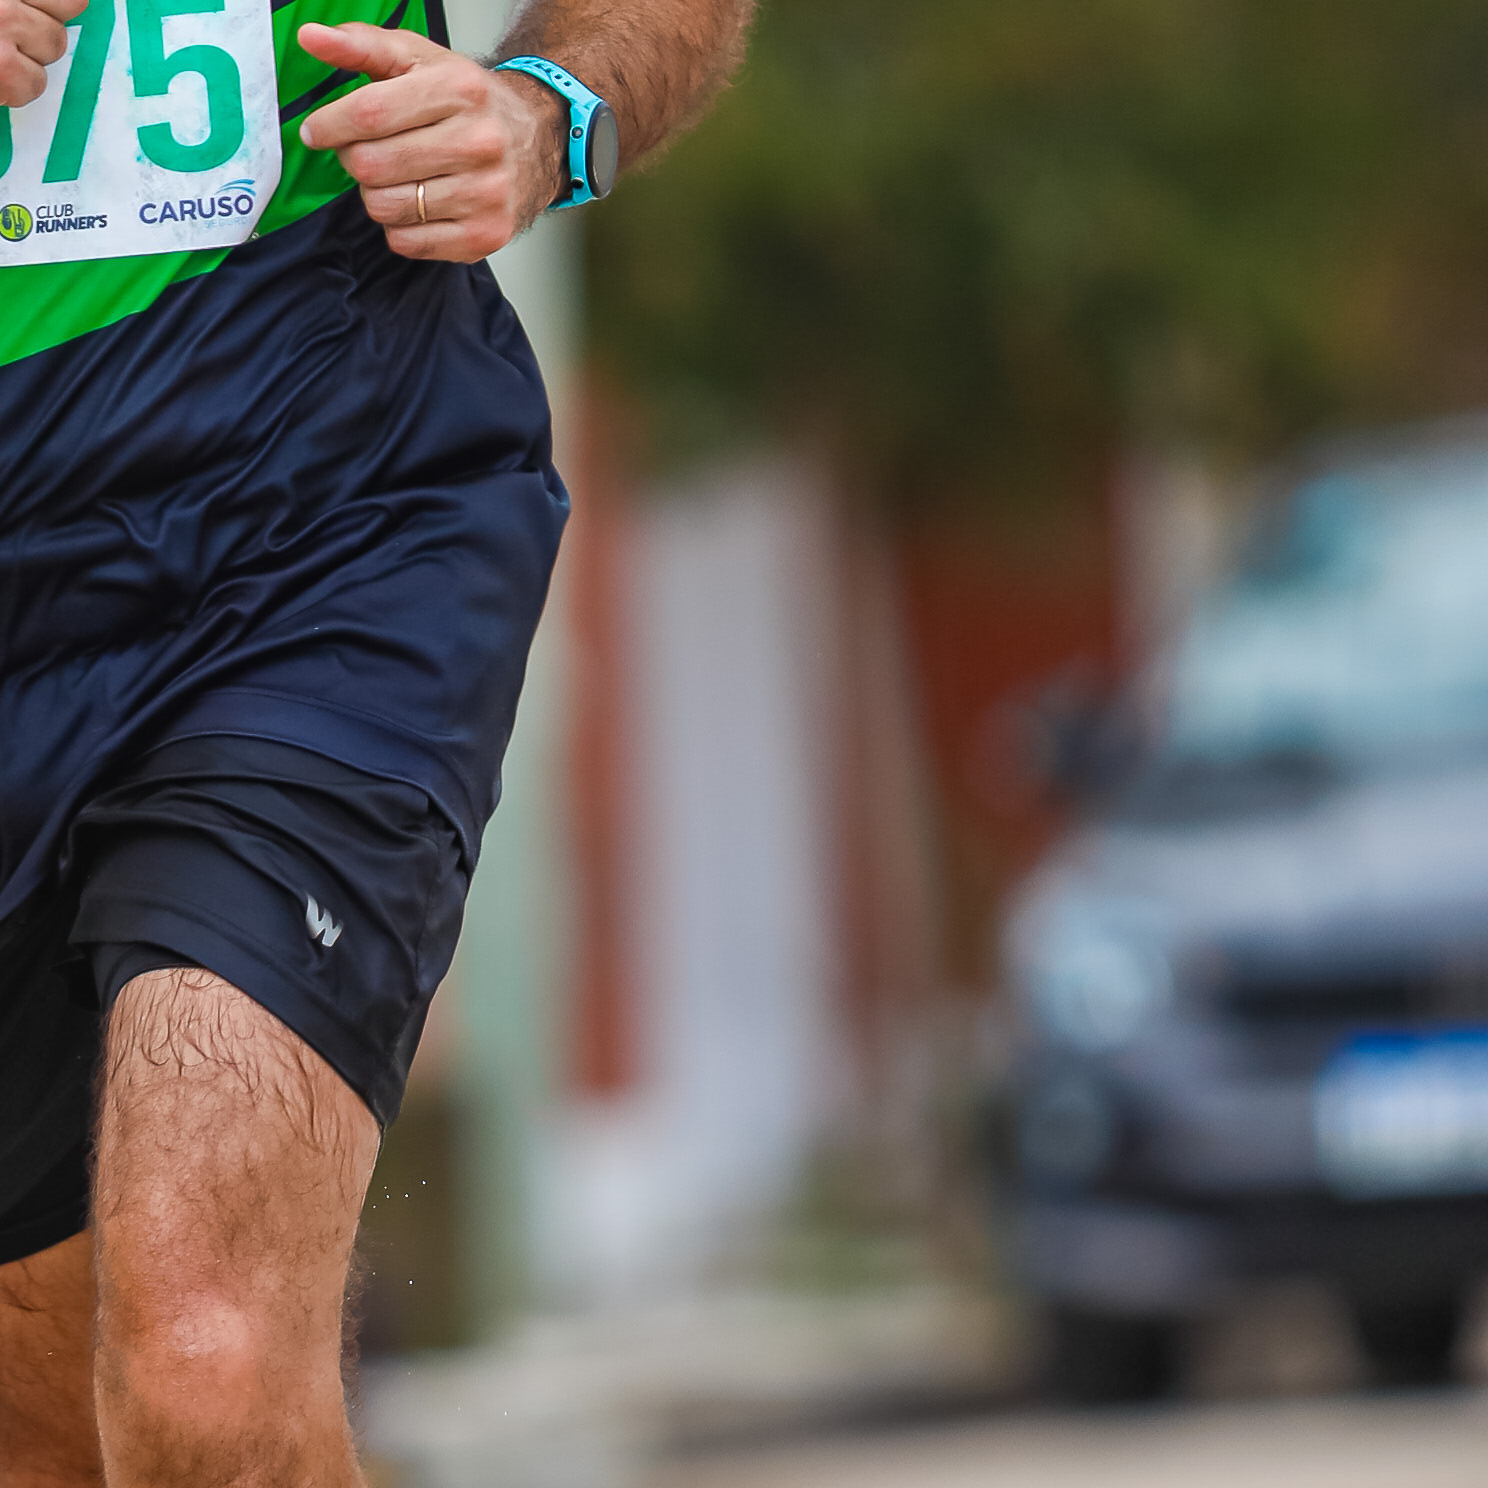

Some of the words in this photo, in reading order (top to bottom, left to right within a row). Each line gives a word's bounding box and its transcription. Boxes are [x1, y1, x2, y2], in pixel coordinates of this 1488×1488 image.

[36, 204, 74, 219] CLUB
[139, 194, 253, 224] CARUSO
[36, 215, 107, 233] RUNNER'S
